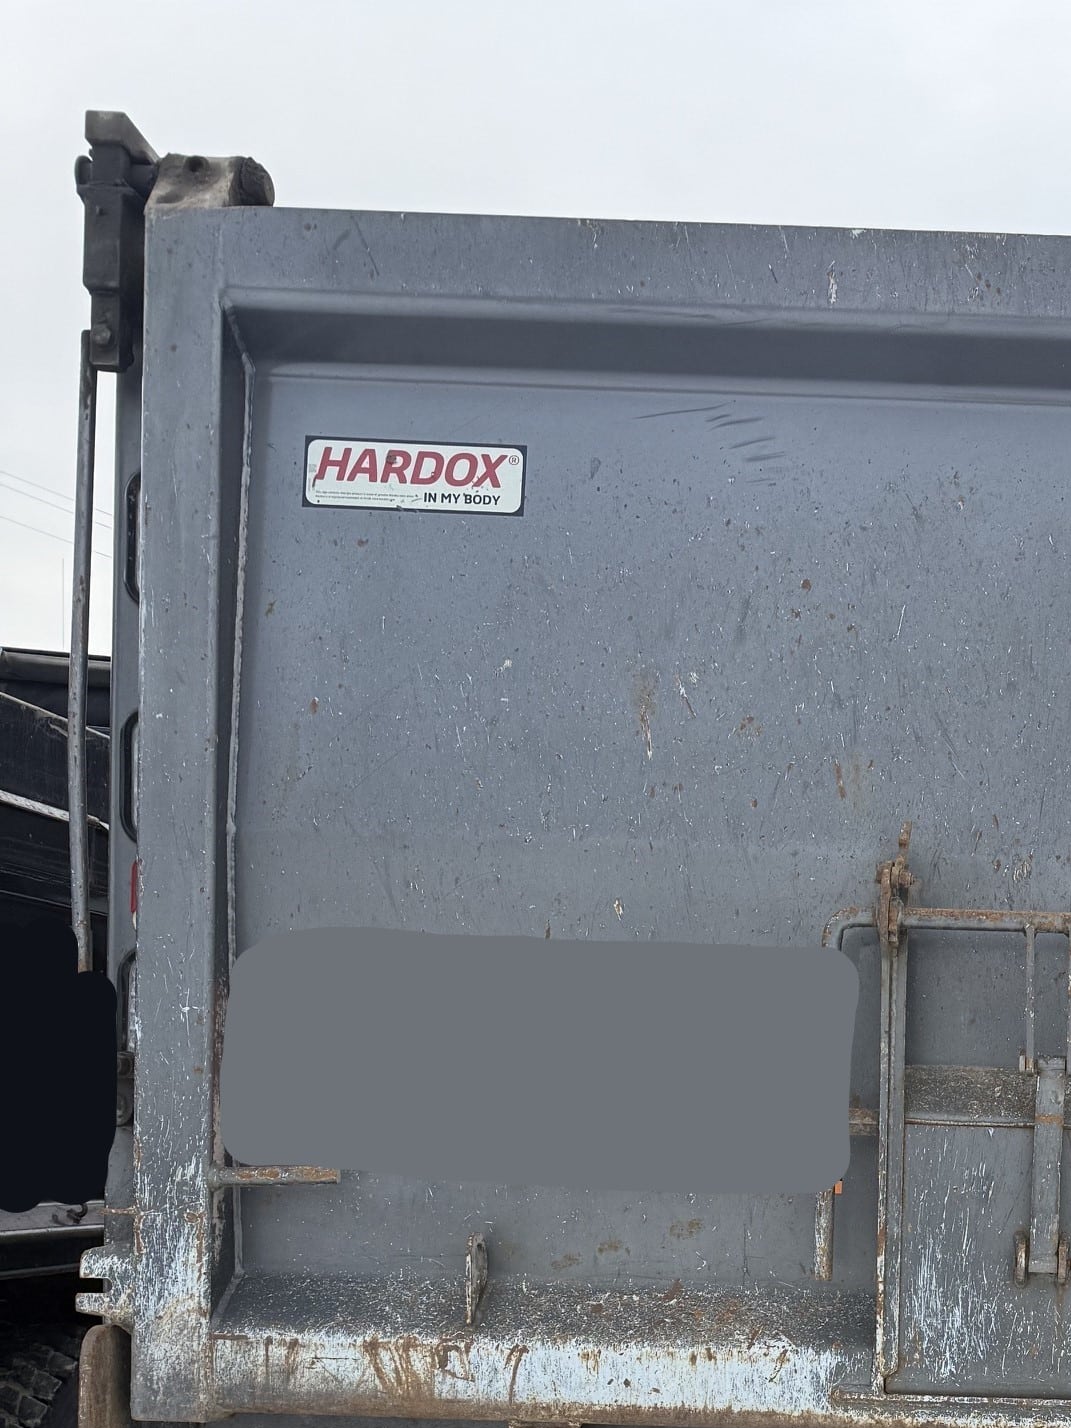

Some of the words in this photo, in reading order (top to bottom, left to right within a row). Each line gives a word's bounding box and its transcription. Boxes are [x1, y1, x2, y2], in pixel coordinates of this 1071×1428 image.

[315, 447, 508, 489] HARDOX
[423, 492, 437, 504] IN
[441, 493, 461, 505] MY
[464, 494, 501, 506] BODY
